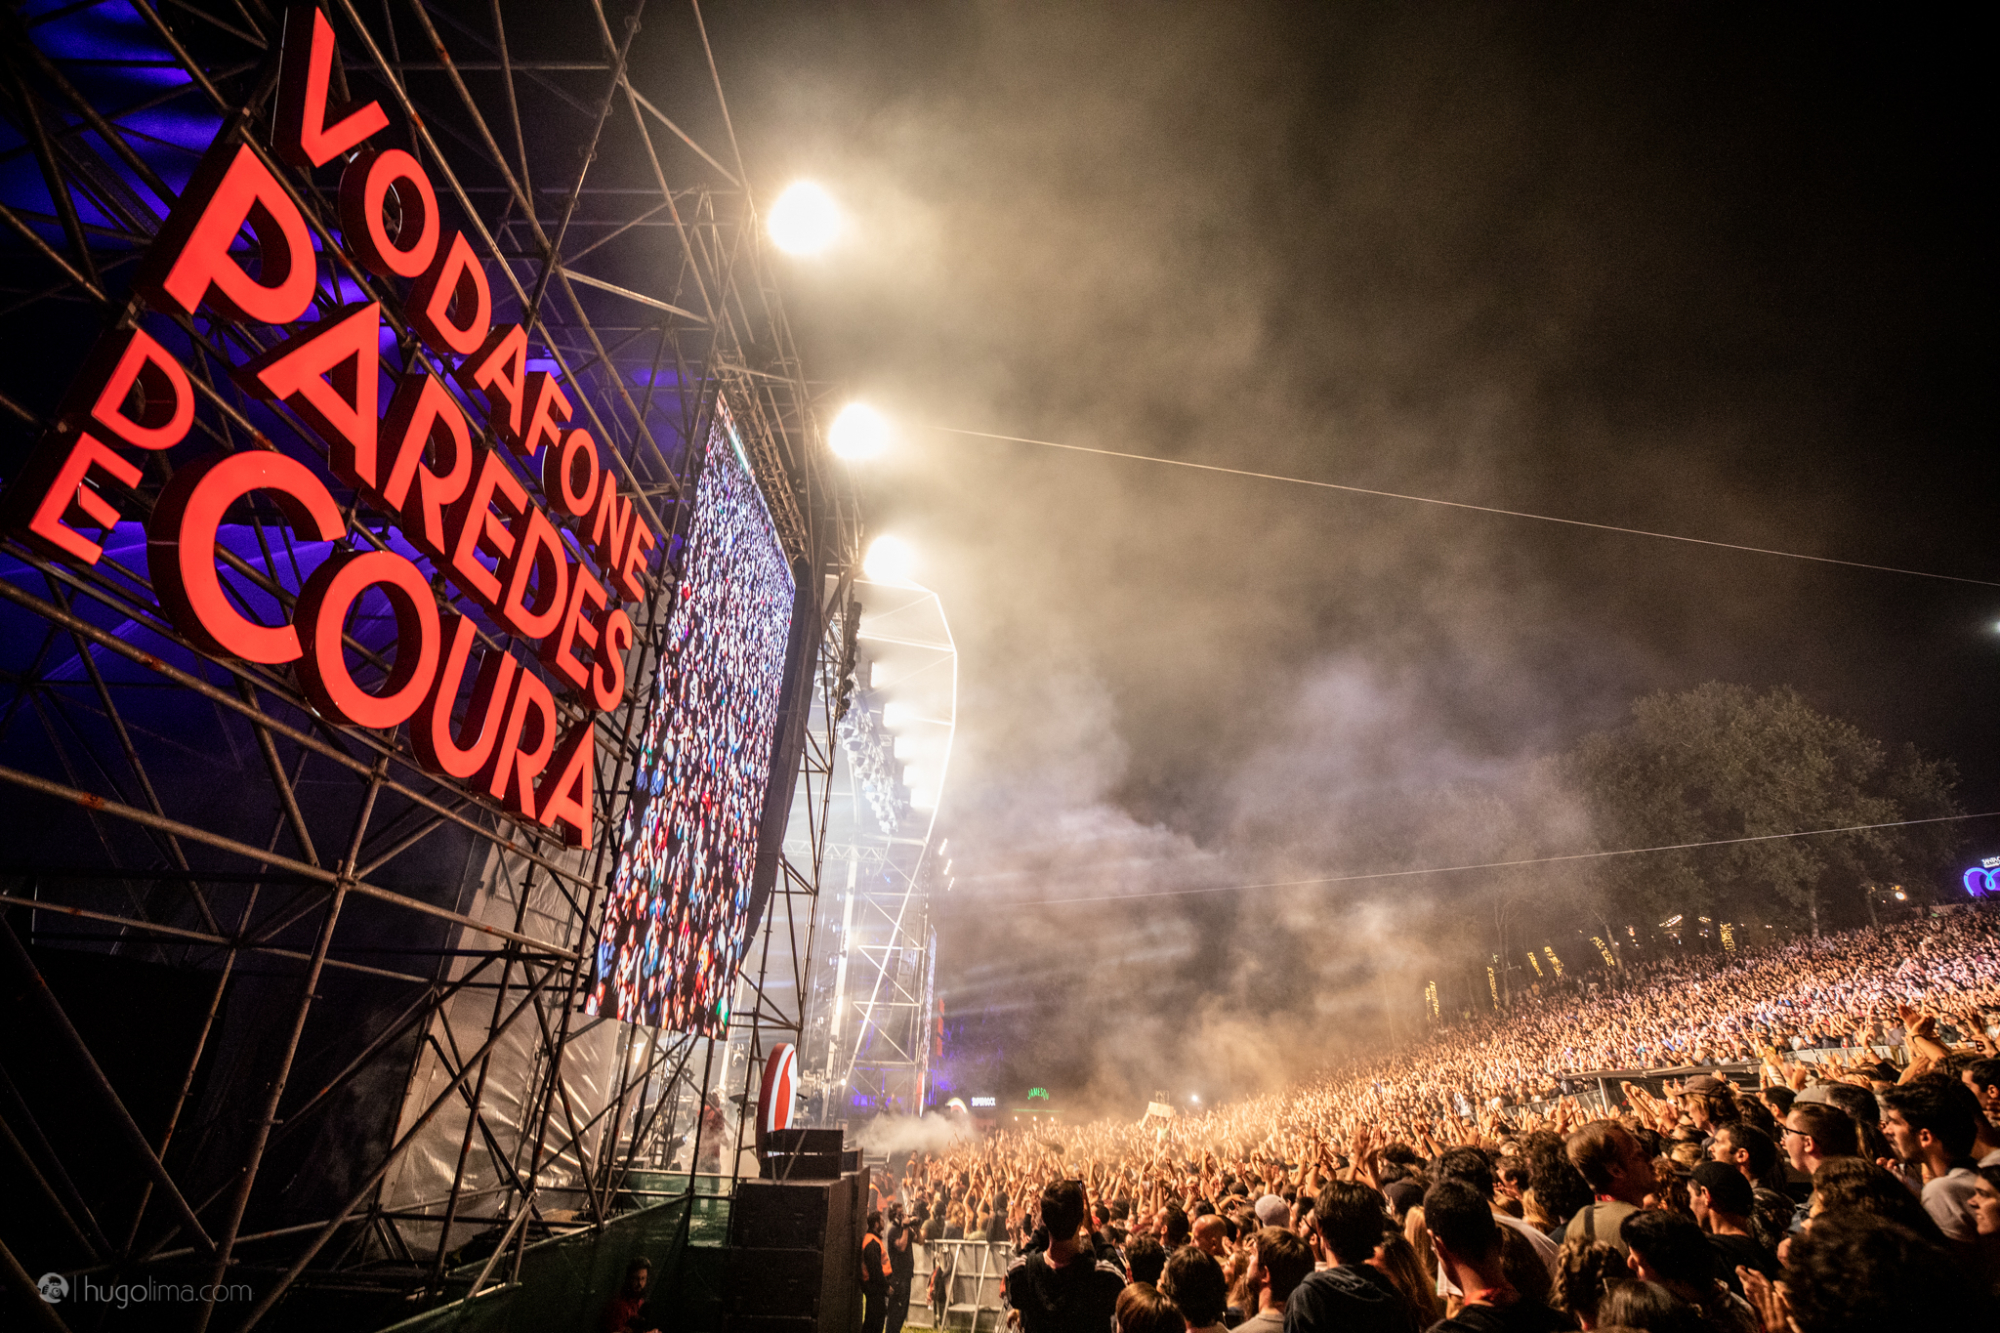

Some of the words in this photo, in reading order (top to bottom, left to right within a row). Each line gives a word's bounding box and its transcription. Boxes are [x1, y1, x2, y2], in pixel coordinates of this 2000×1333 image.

[163, 143, 633, 713] PAREDES
[300, 7, 656, 604] VODAFONE
[179, 450, 595, 851] COURA
